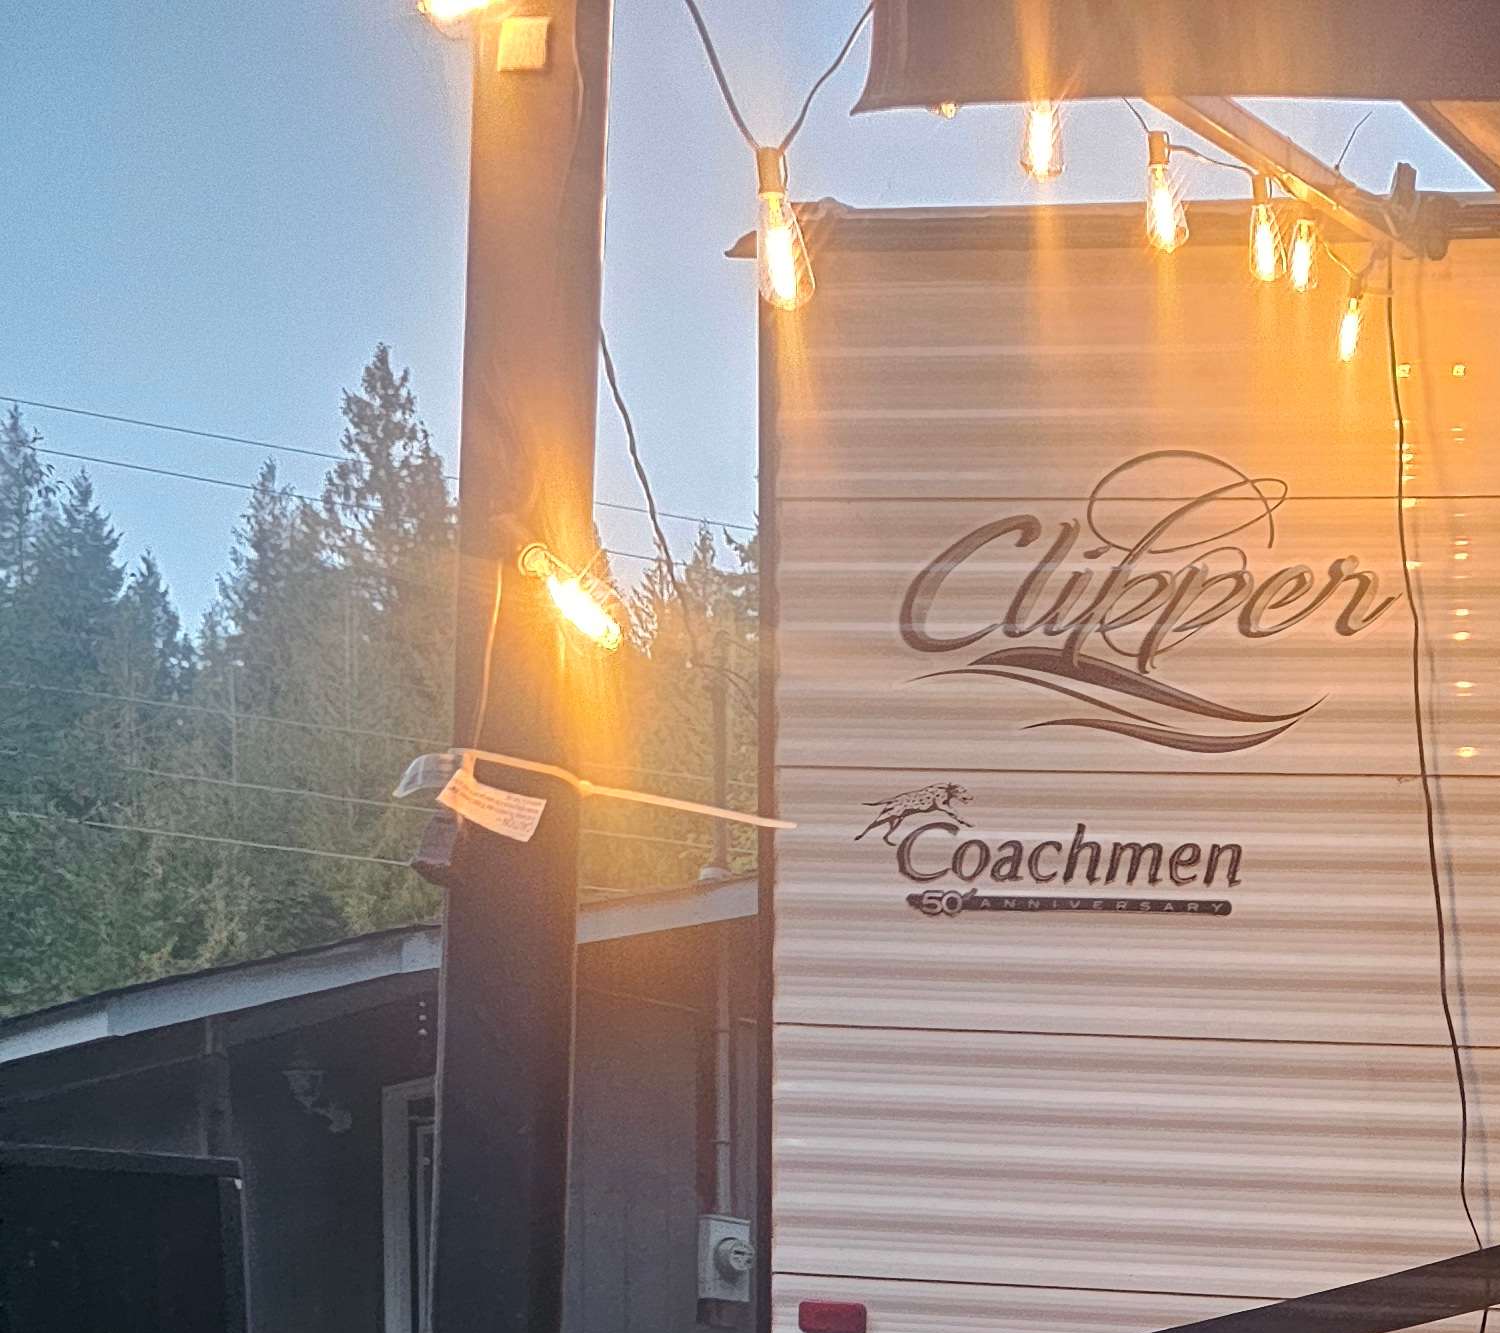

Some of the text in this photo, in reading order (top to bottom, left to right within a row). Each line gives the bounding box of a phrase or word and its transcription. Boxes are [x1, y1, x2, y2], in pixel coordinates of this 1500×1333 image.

[899, 449, 1403, 674] Clipper
[896, 821, 1242, 887] Coachmen
[977, 897, 1225, 913] ANNIVERSARY
